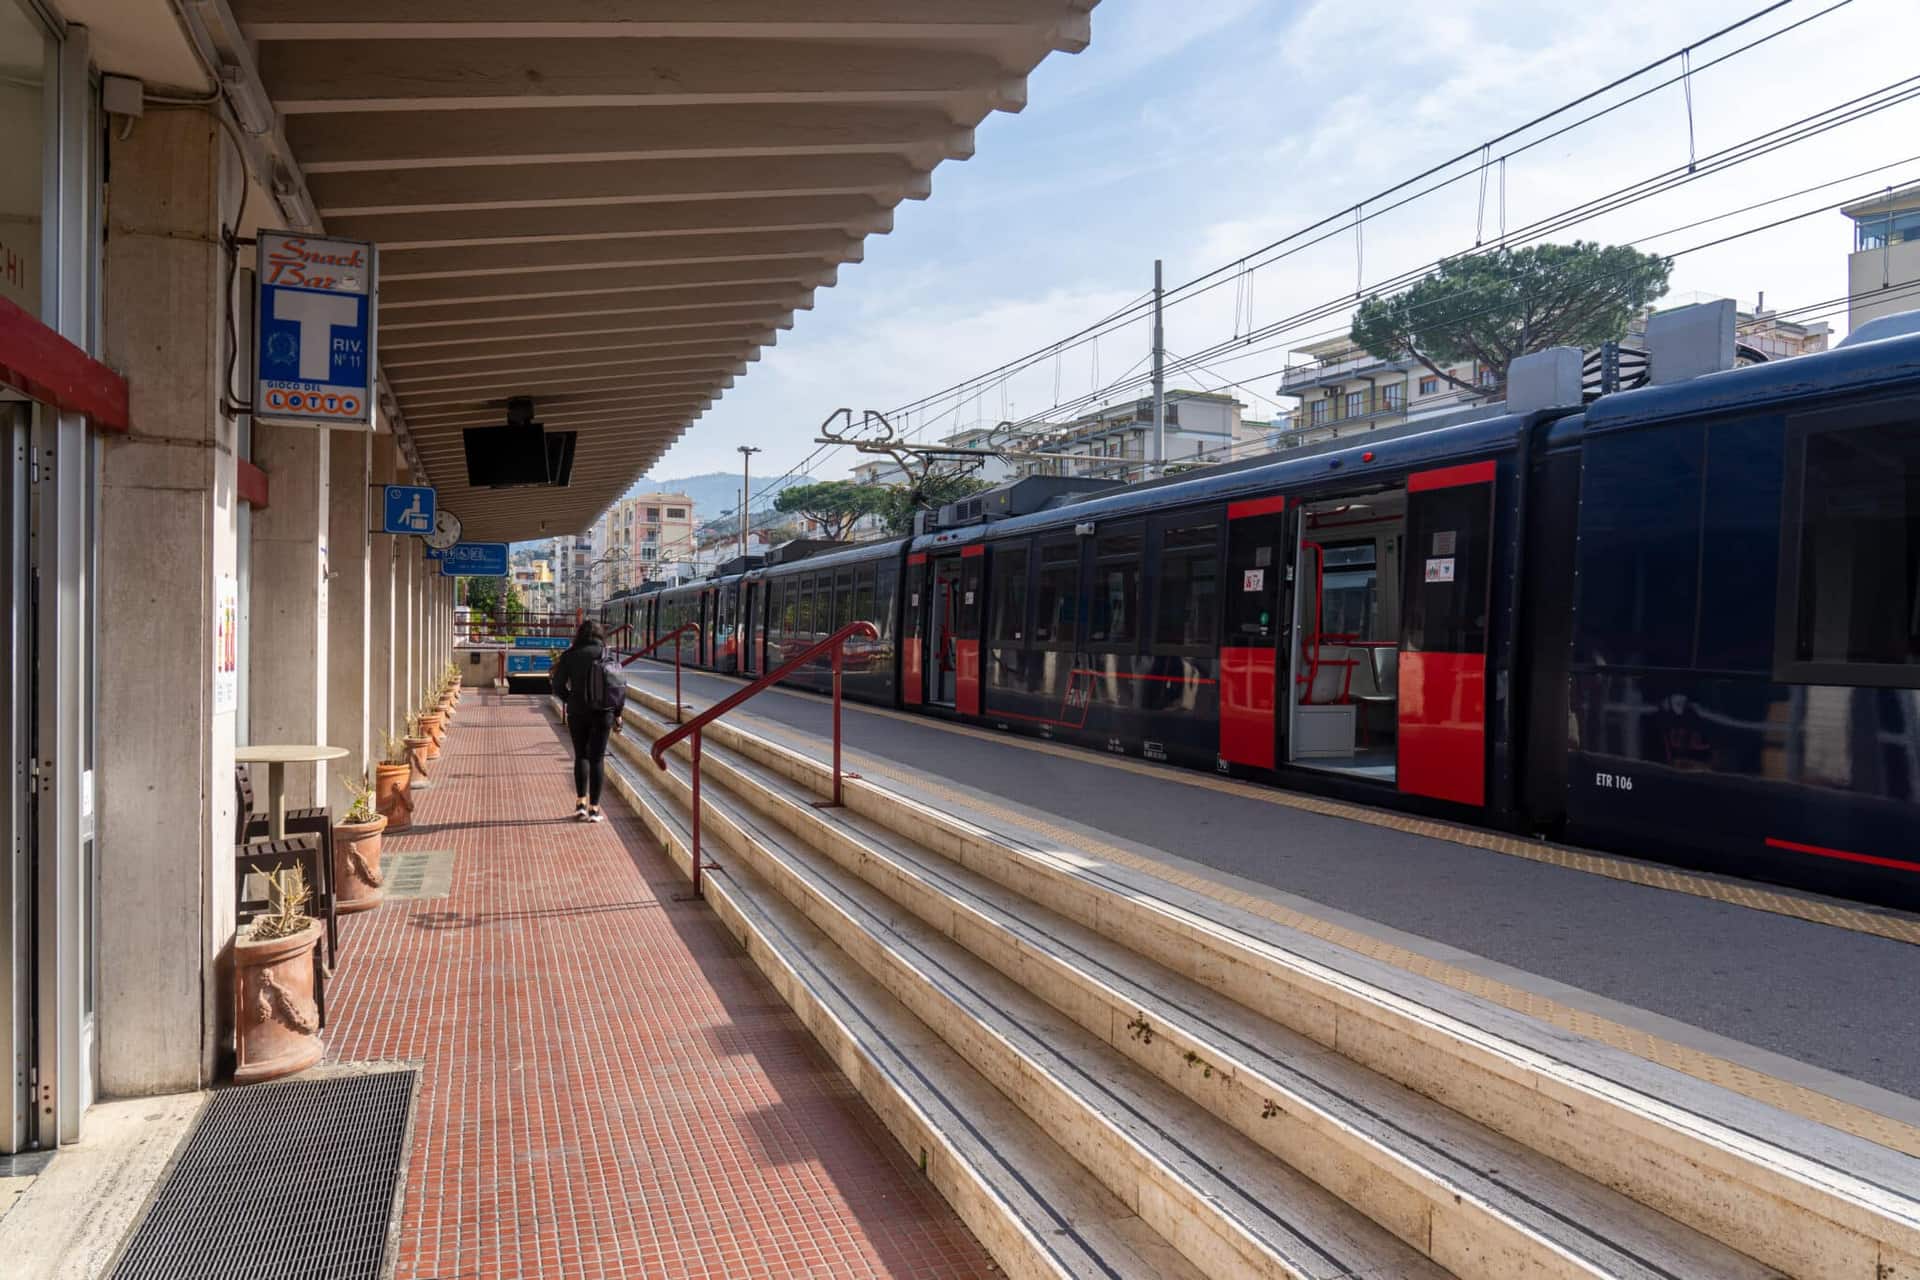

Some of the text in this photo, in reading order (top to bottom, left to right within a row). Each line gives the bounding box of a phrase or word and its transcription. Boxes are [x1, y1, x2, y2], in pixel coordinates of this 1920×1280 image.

[269, 238, 364, 268] Snack
[268, 260, 336, 288] Bar
[273, 289, 359, 381] T
[333, 338, 363, 353] RIV.
[350, 355, 361, 368] 11
[267, 380, 321, 392] GIOCO DEL
[268, 391, 357, 413] LOTTO
[1596, 772, 1632, 790] ETR 106
